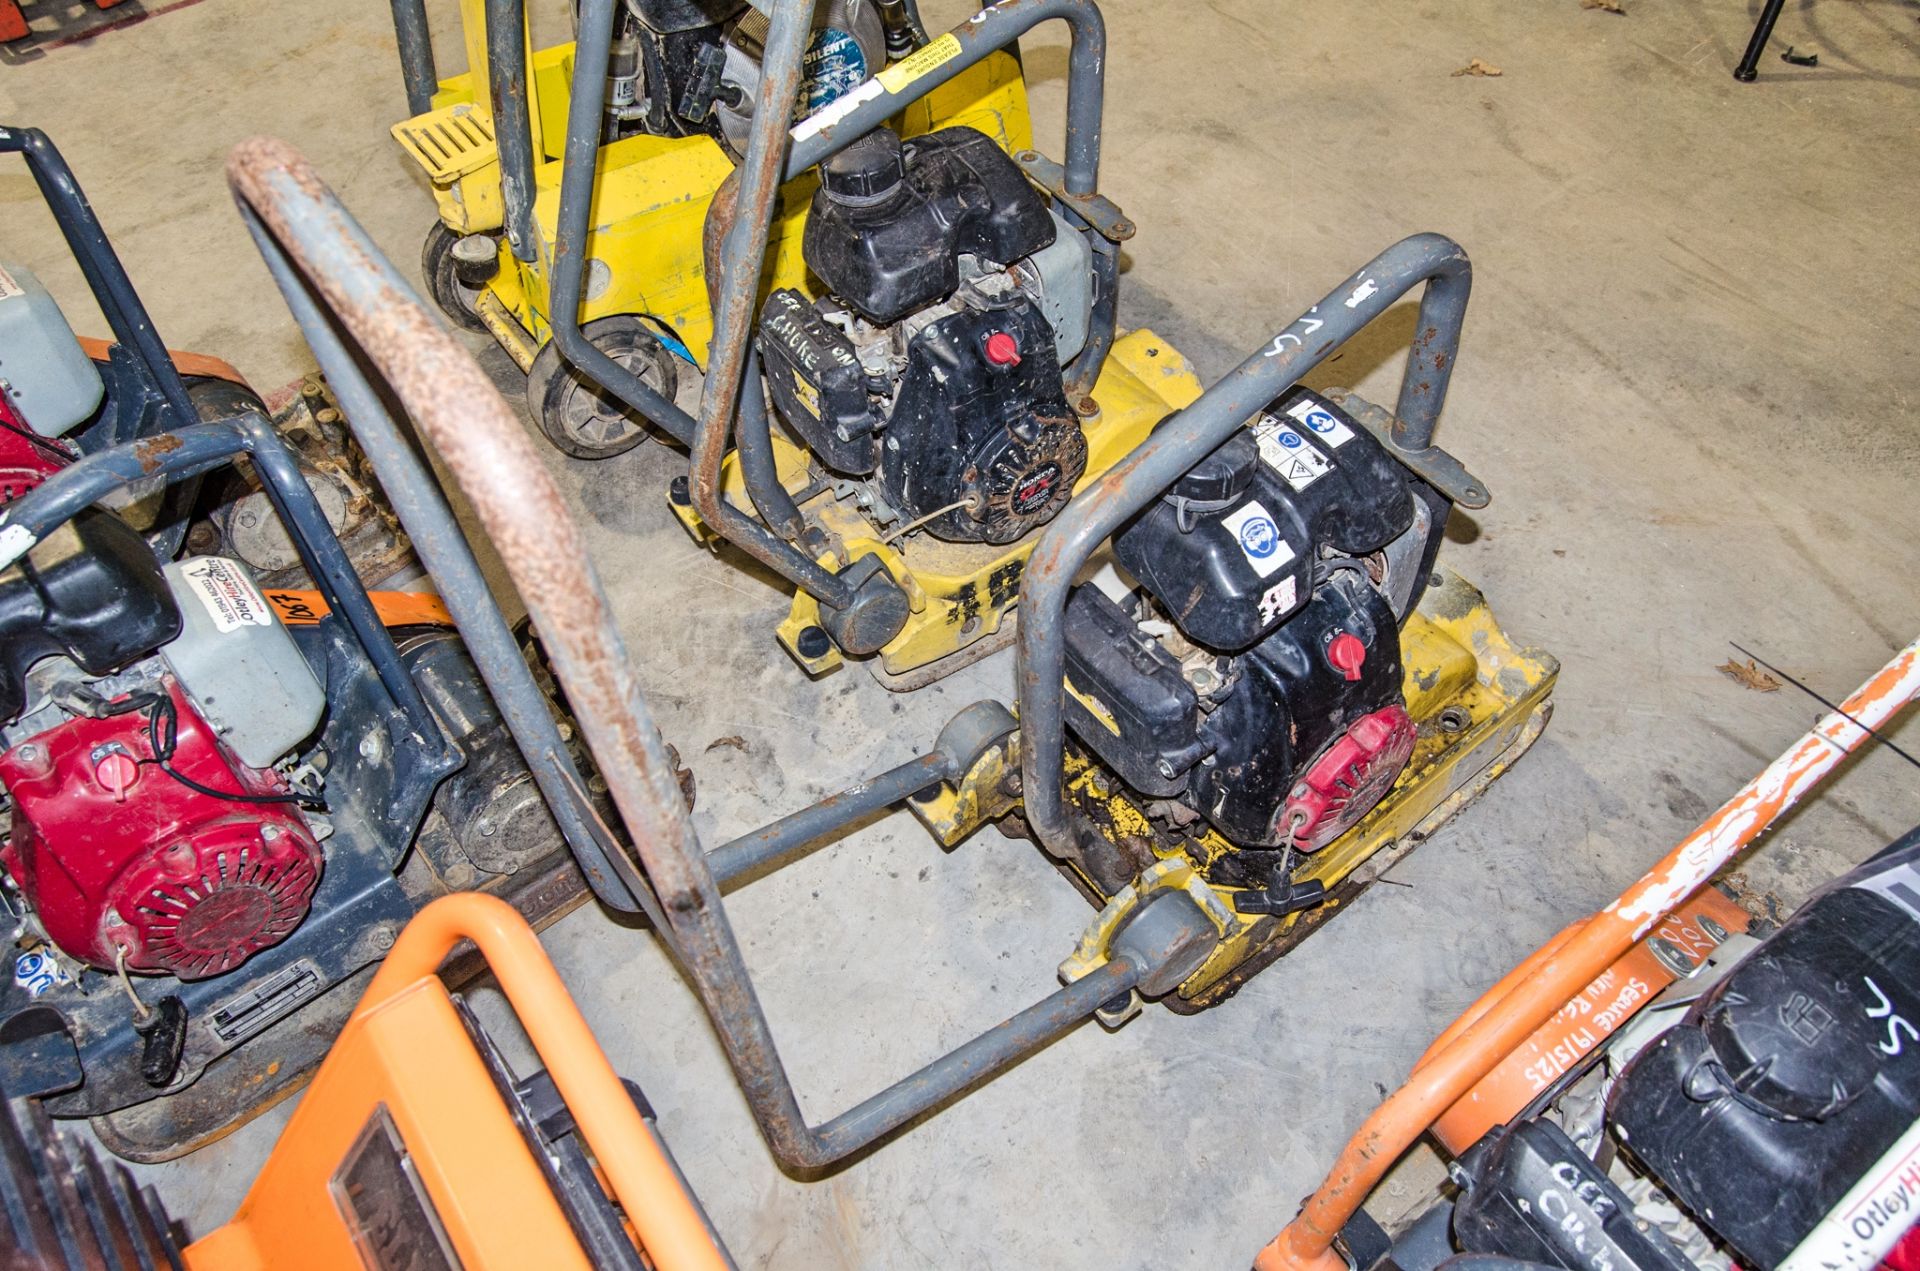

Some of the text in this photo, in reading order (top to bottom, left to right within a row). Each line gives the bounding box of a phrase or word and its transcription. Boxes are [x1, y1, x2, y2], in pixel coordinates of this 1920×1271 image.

[804, 40, 848, 65] SILENT
[831, 346, 856, 367] ON
[1524, 976, 1649, 1091] SERVICE 19/5/25
